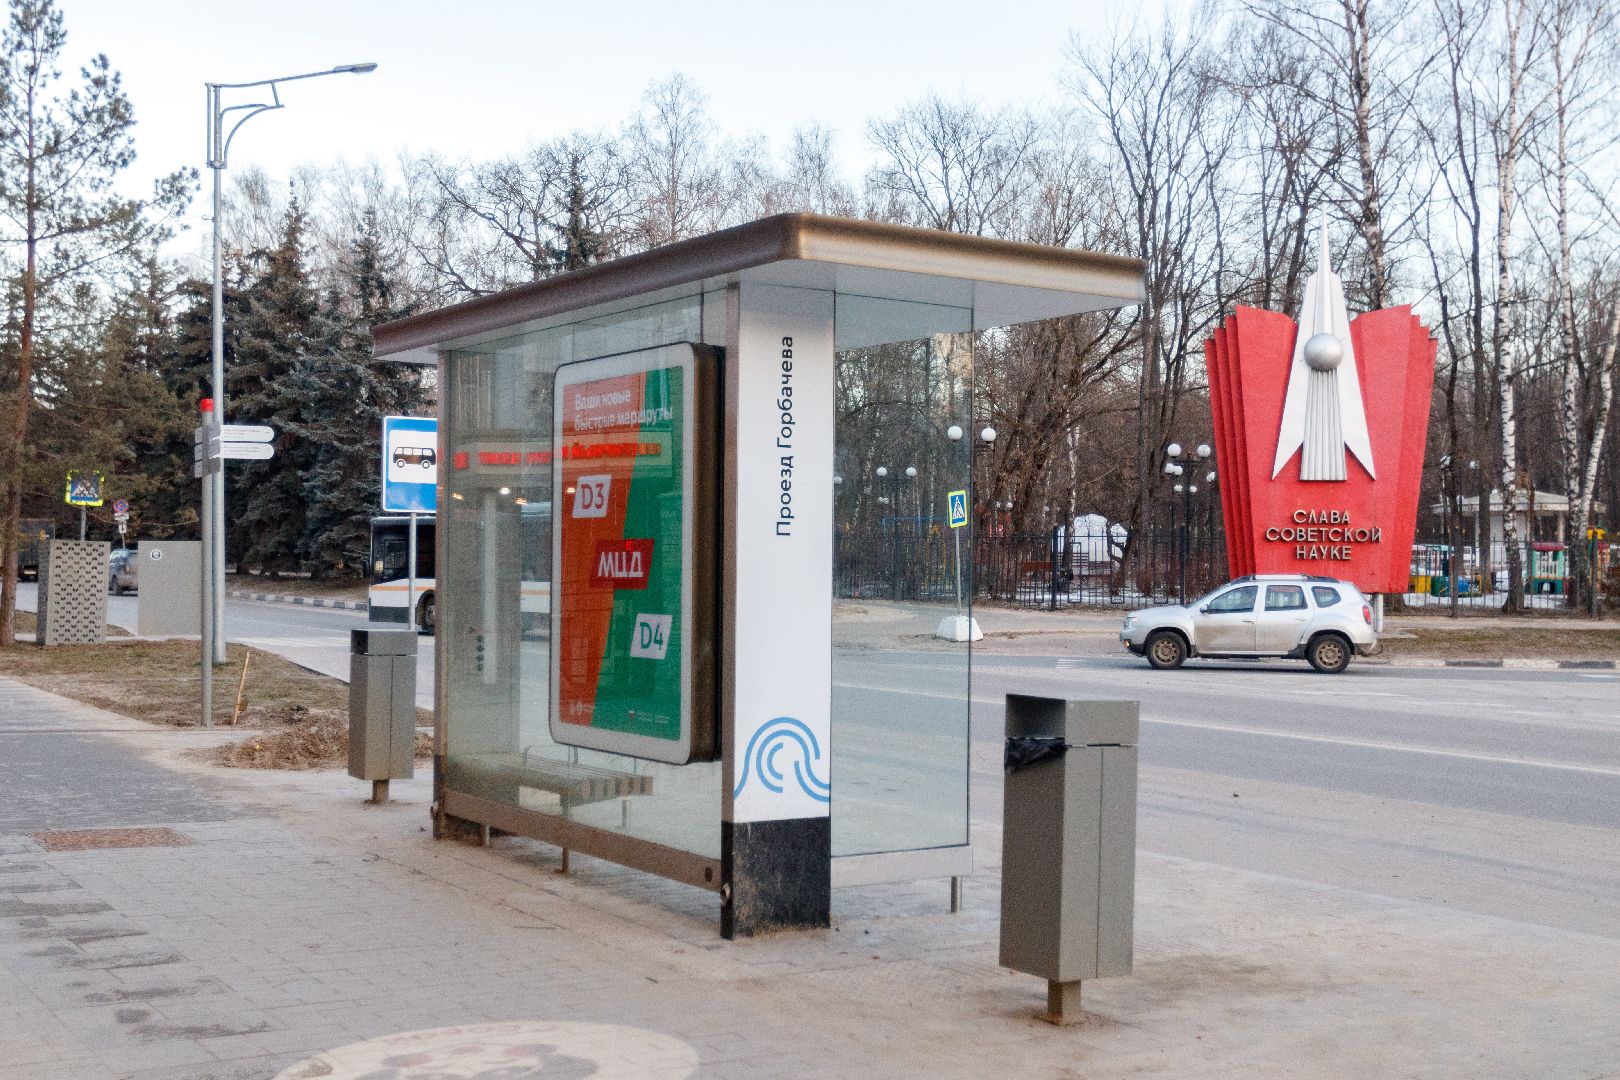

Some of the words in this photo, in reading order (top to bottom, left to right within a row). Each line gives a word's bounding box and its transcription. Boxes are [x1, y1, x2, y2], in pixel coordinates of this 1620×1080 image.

[575, 392, 601, 411] Ваши
[601, 388, 631, 407] новые
[777, 336, 796, 448] Горбачева
[574, 412, 616, 431] быстрые
[617, 406, 673, 428] маршруты
[580, 483, 605, 510] D3
[776, 456, 794, 536] Проезд
[1293, 508, 1351, 524] СЛАВА
[597, 551, 644, 578] МЦД
[1296, 544, 1352, 560] НАУКЕ
[639, 621, 664, 651] D4
